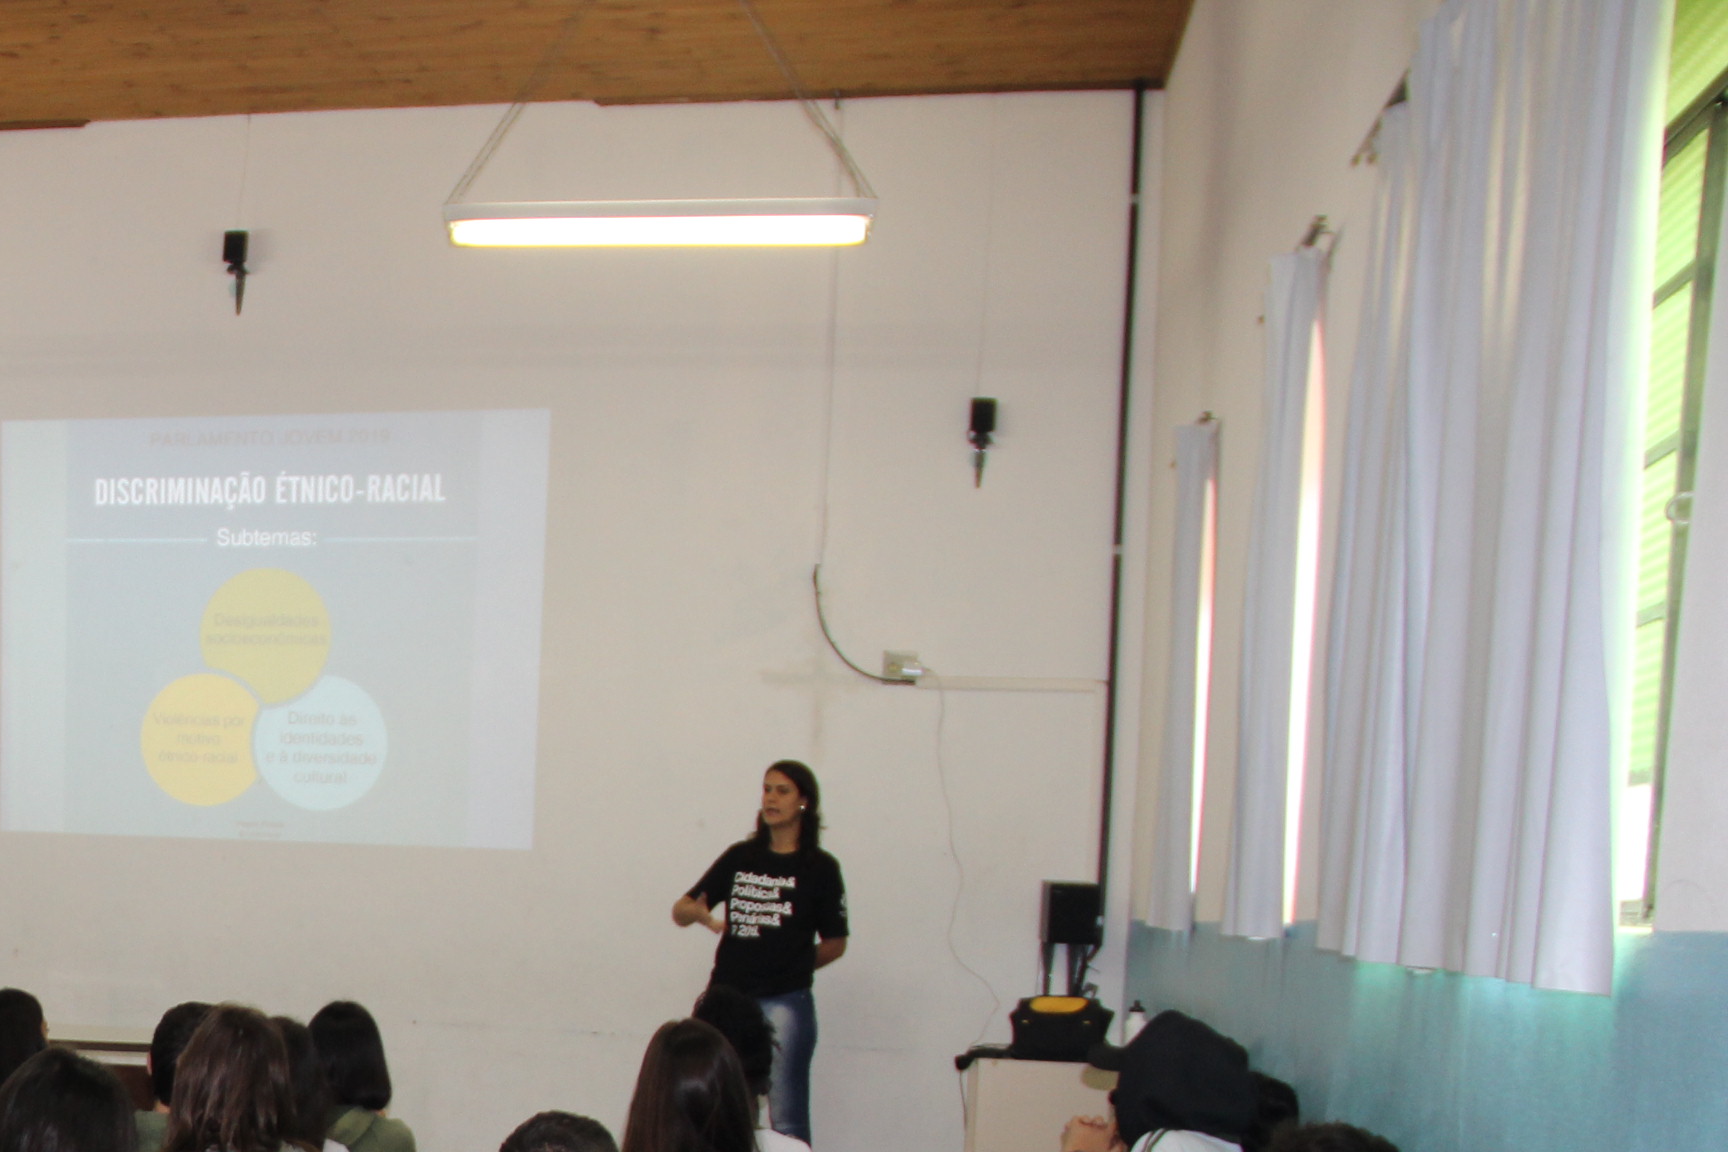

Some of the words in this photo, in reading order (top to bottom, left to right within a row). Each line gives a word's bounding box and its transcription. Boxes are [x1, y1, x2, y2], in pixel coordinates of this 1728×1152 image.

[149, 430, 274, 447] PARLAMENTO
[282, 428, 344, 445] JOVEM
[94, 472, 267, 510] DISCRIMINAÇÃO
[274, 471, 446, 504] ÉTNICO-RACIAL
[216, 528, 318, 547] Subtemas:
[288, 711, 335, 726] Direito
